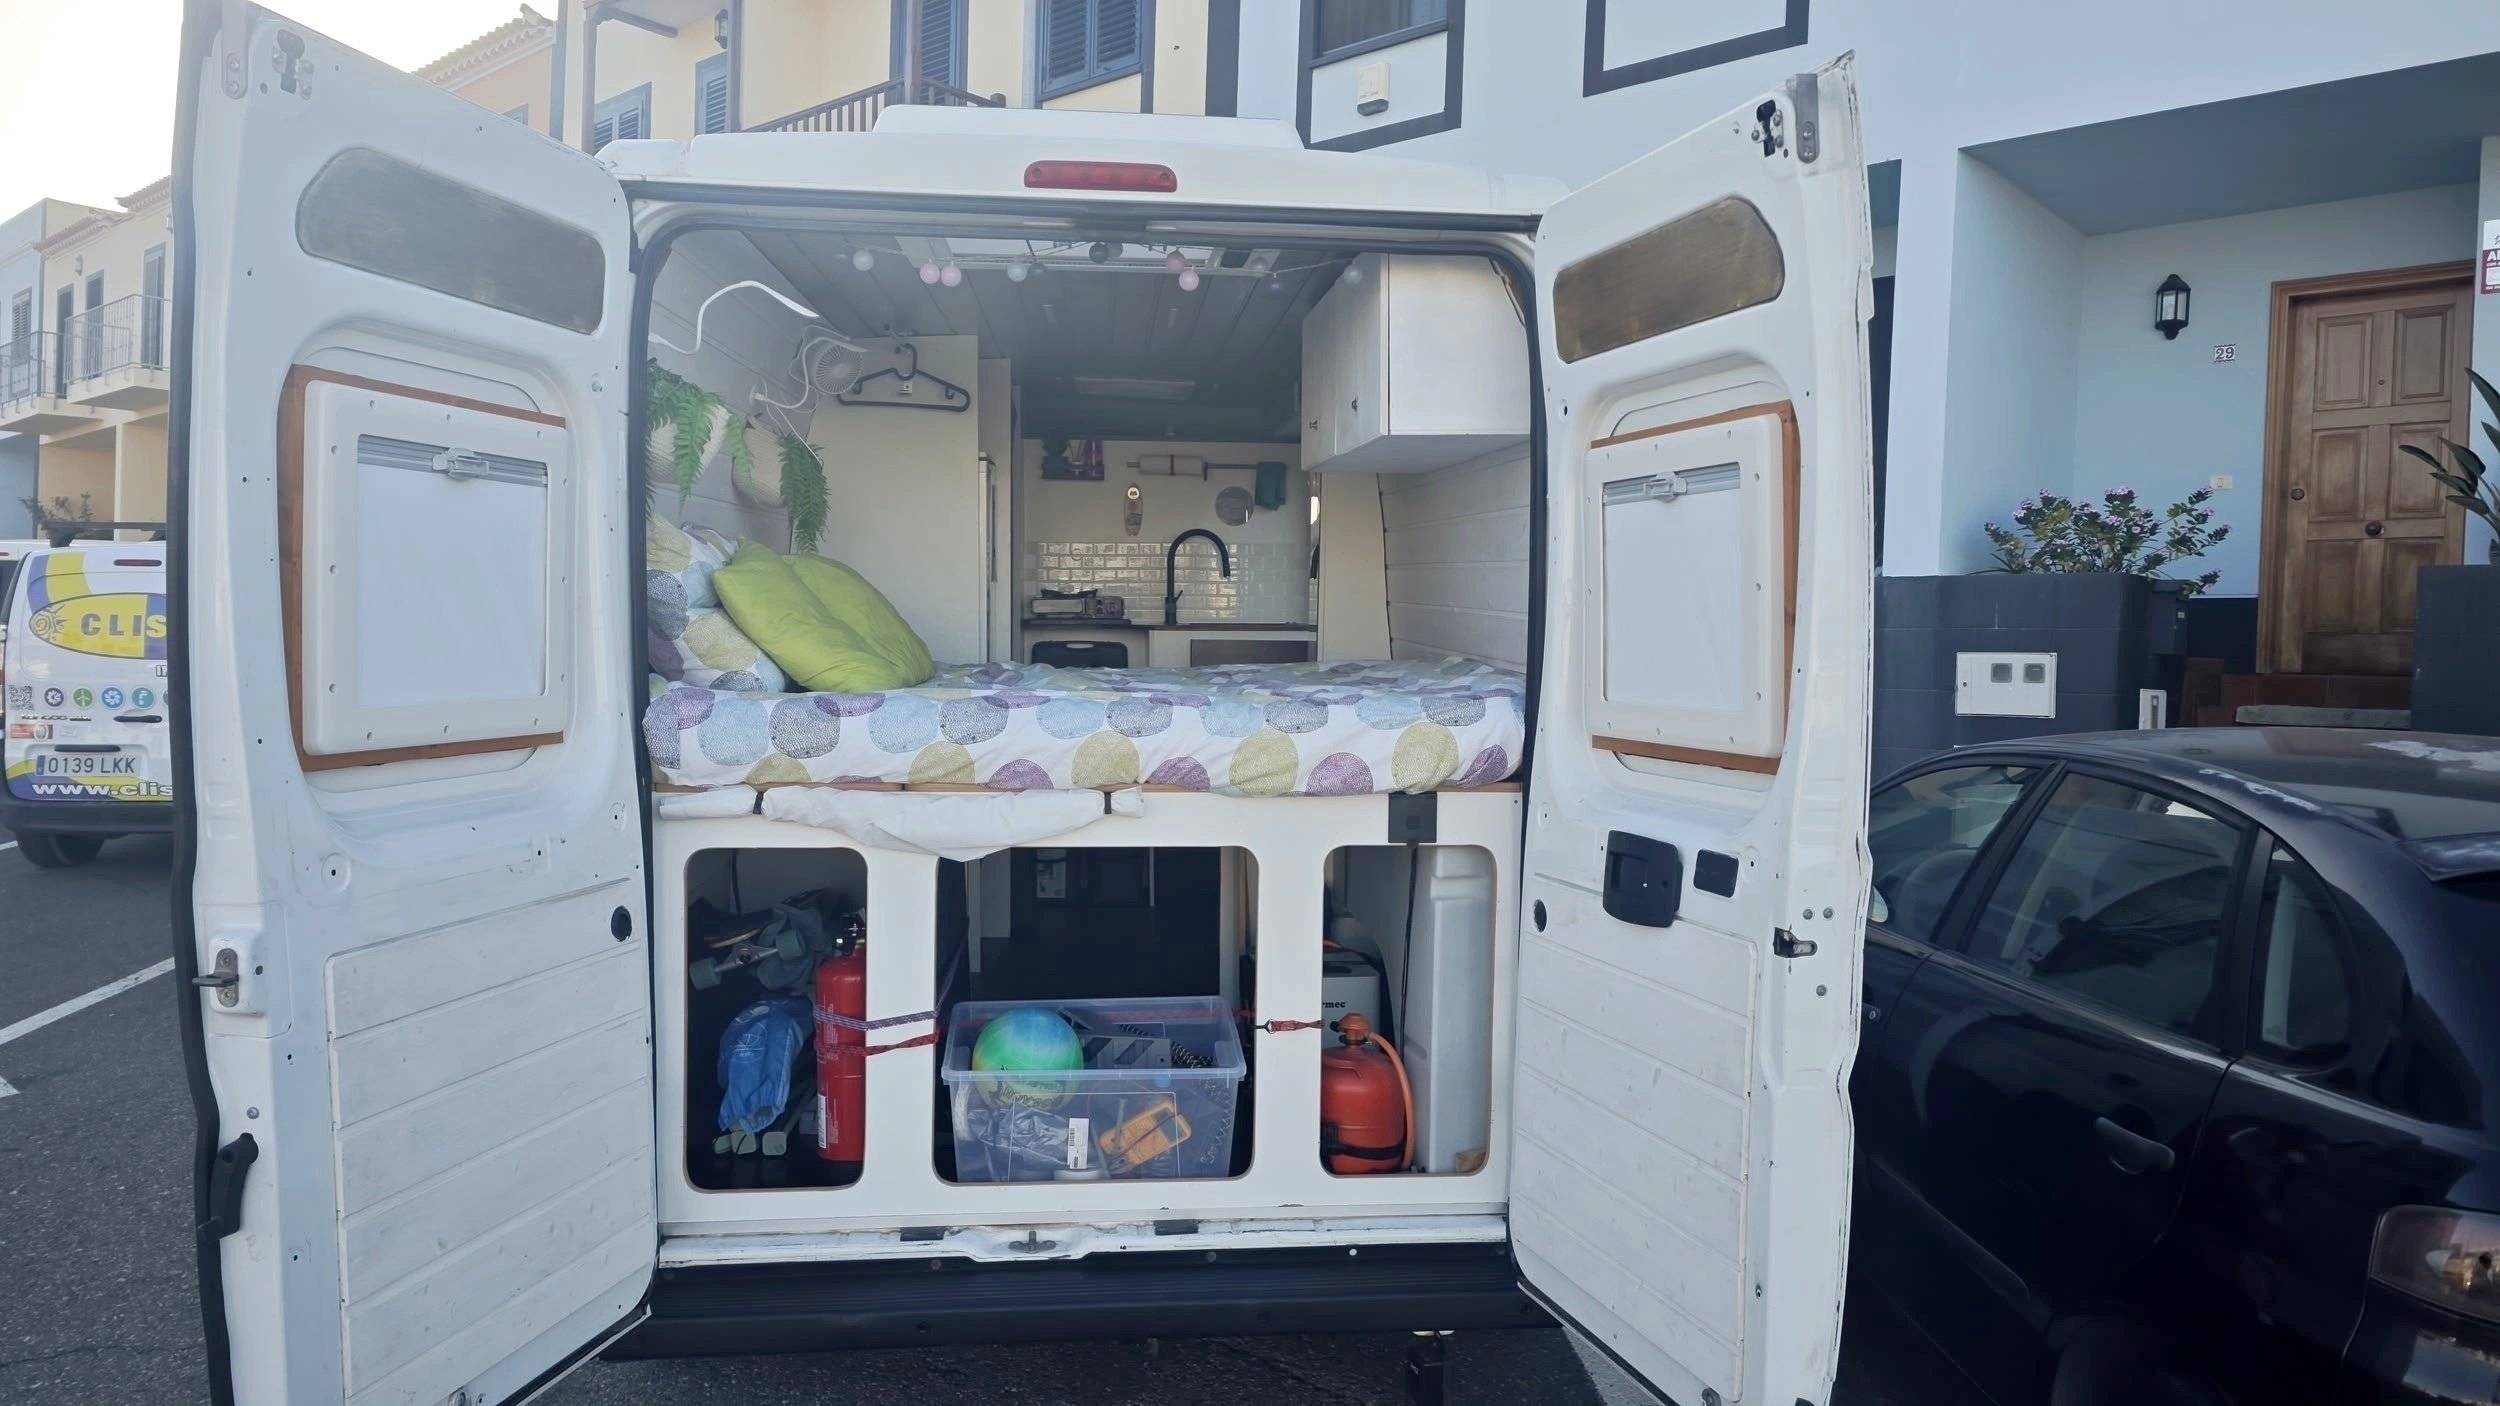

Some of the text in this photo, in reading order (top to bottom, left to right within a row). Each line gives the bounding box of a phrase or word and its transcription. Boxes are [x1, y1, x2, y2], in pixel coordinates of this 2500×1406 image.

[2216, 347, 2235, 360] 29
[81, 613, 167, 639] CLIS
[48, 757, 136, 774] 0139 LKK
[31, 781, 174, 797] www.clis
